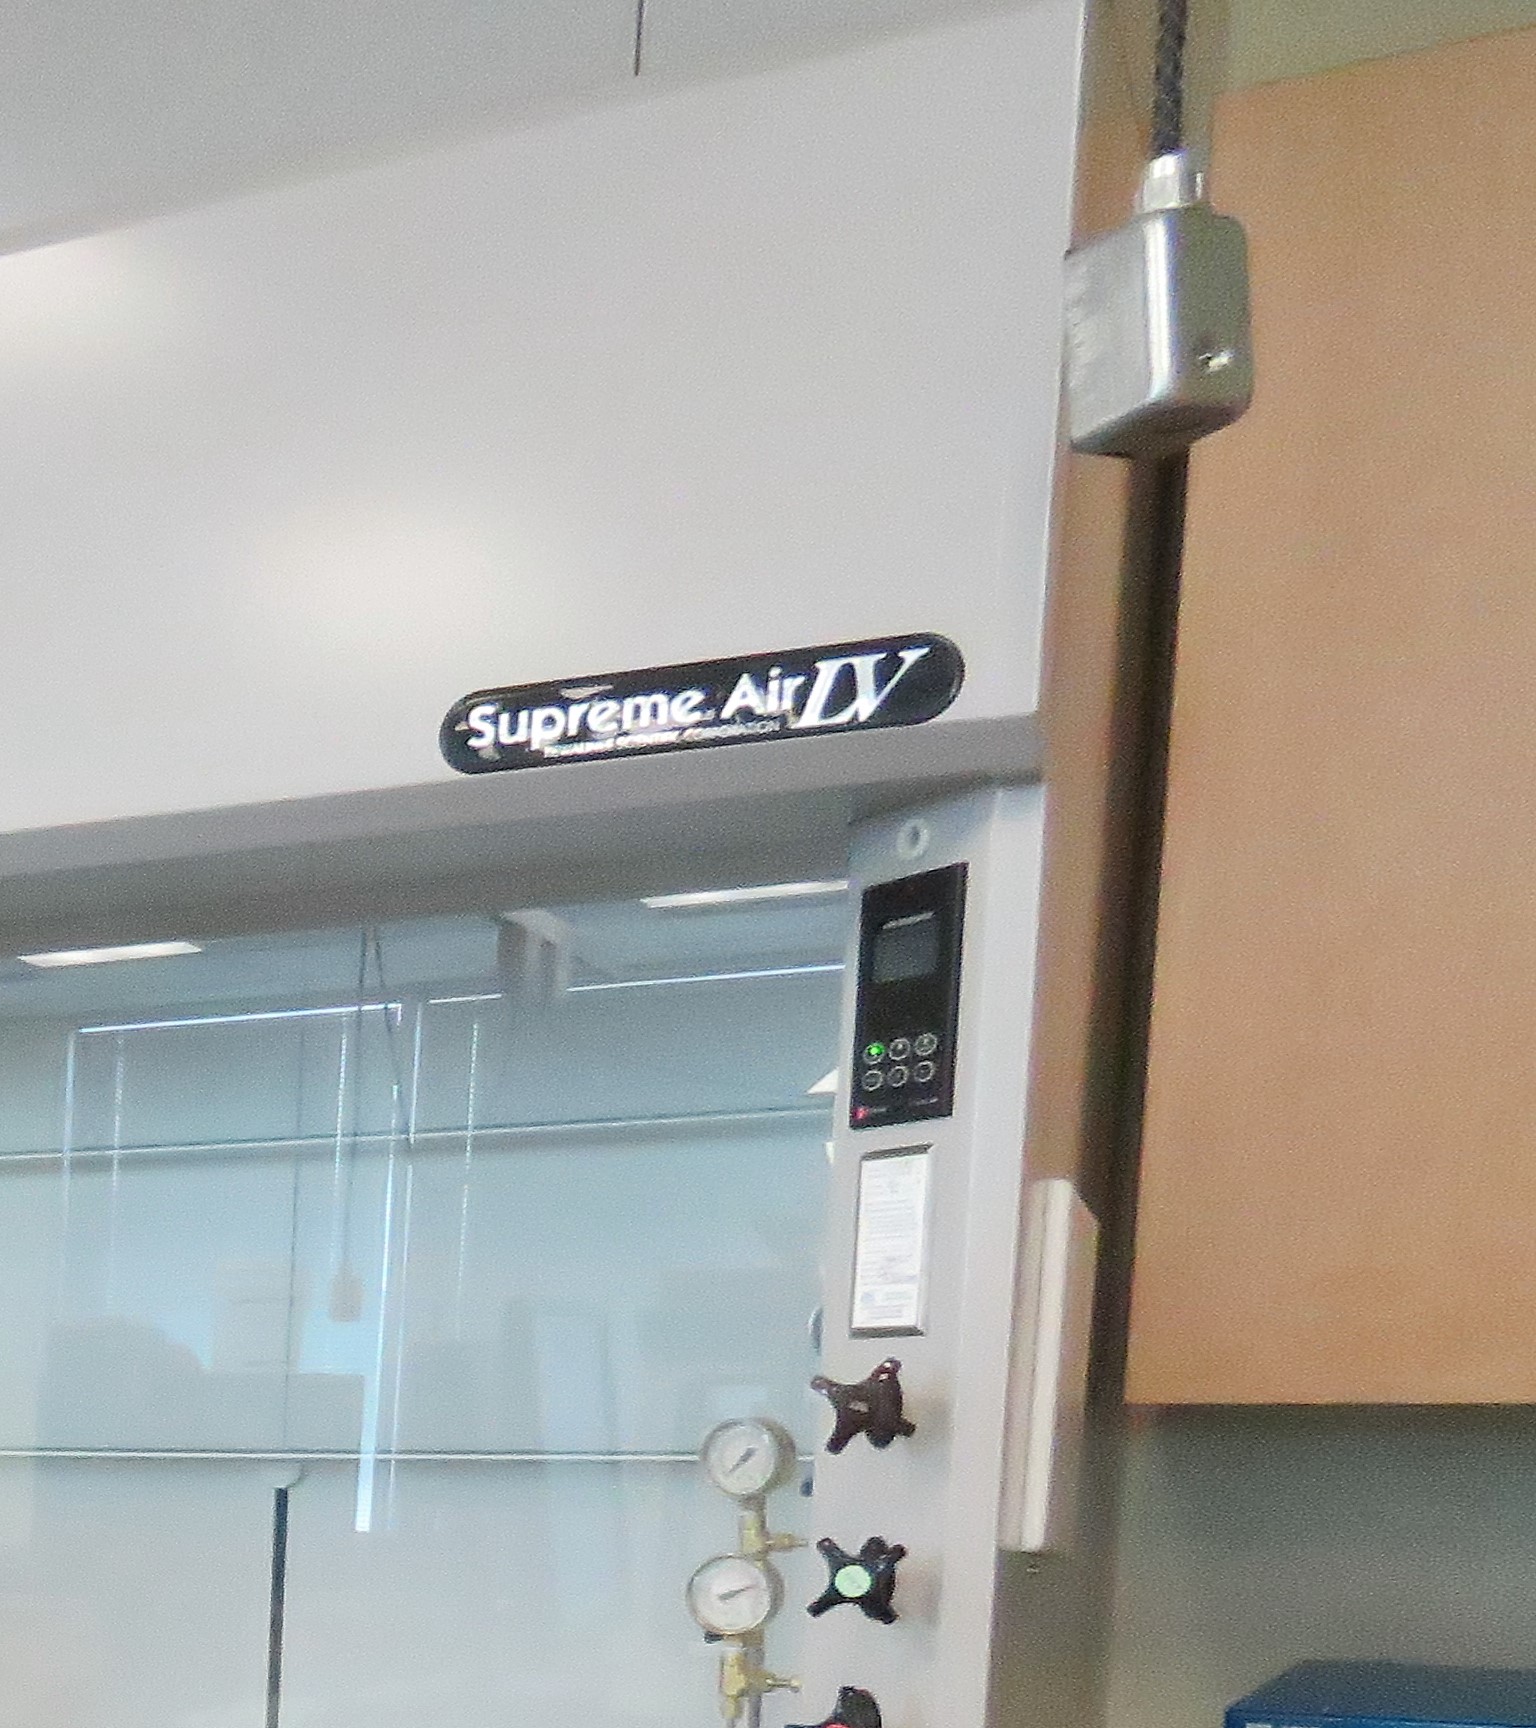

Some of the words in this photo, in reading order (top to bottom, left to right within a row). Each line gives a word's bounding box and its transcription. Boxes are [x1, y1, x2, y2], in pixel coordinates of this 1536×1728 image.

[466, 688, 706, 751] Supreme
[720, 666, 805, 720] Air
[792, 647, 931, 729] IV
